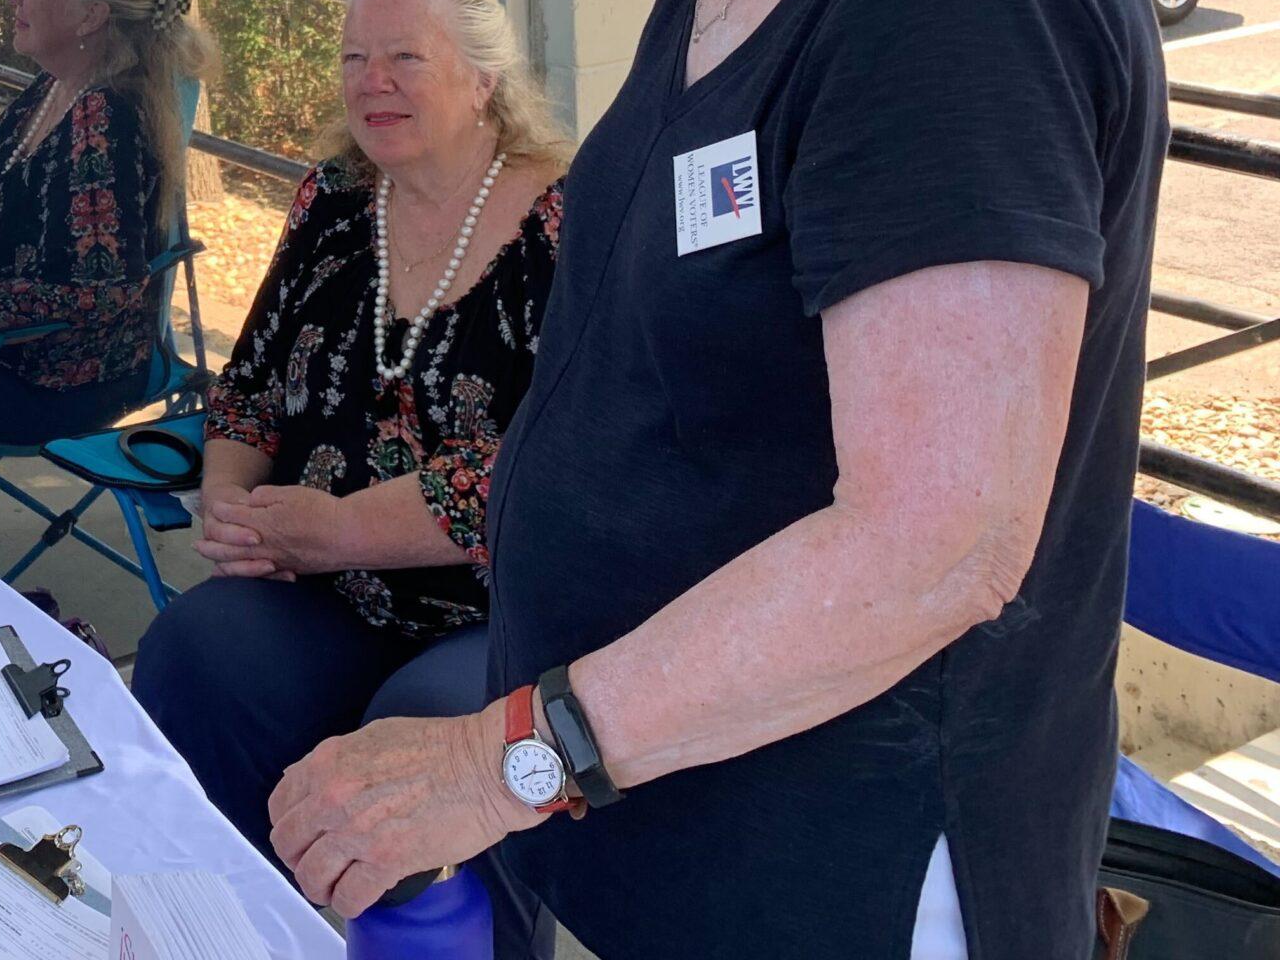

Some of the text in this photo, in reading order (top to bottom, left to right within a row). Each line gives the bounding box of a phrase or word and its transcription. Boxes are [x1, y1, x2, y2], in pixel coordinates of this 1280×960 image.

[687, 153, 695, 197] WOMEN
[697, 164, 708, 228] LEAGUE OF
[731, 156, 754, 209] LWV
